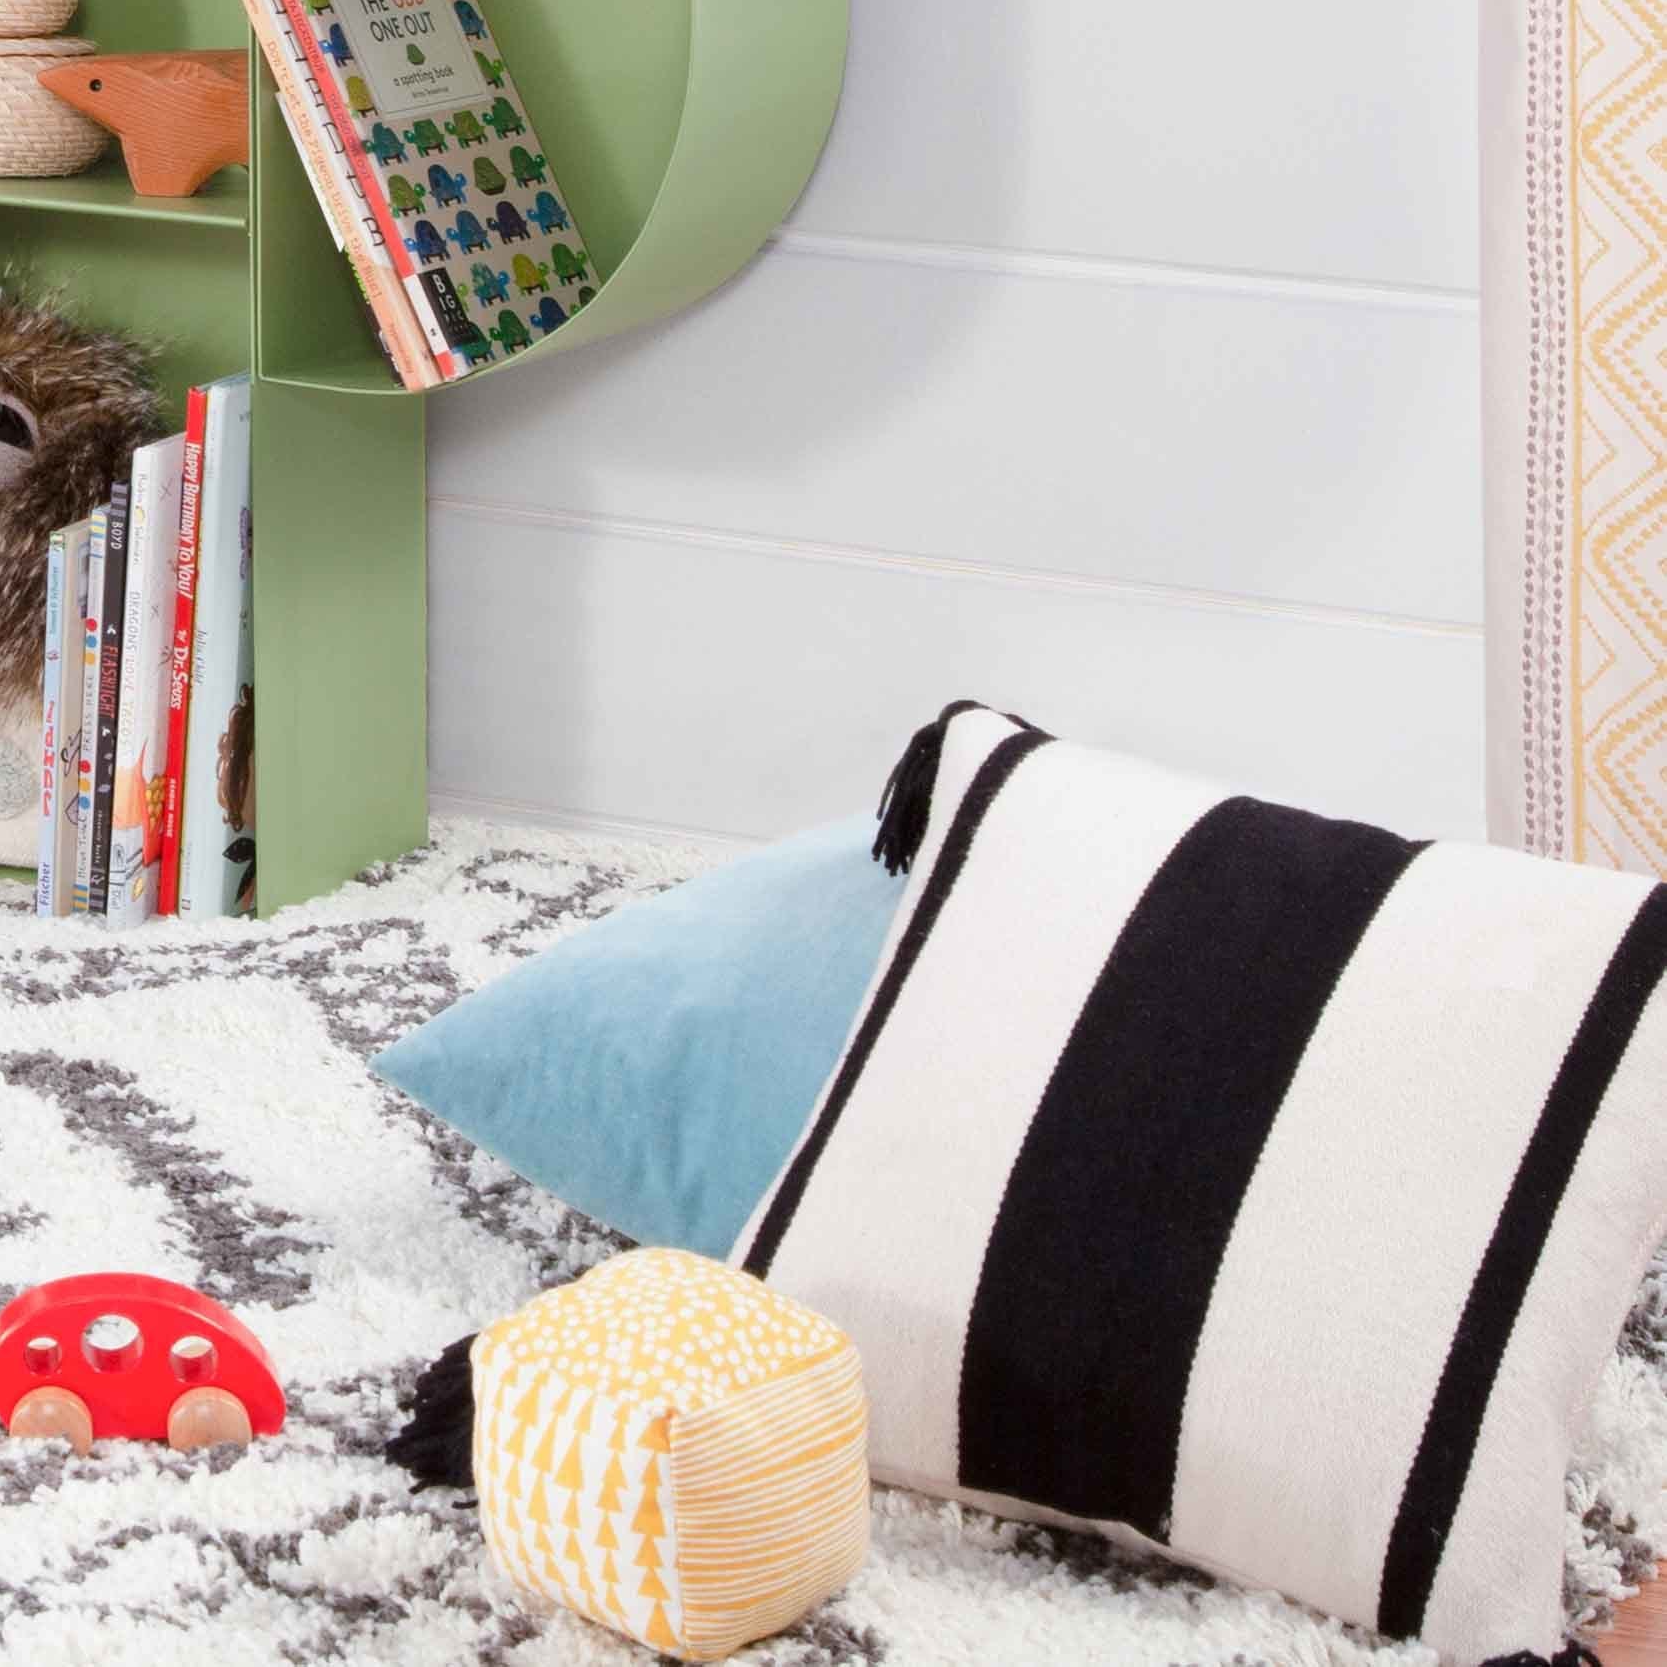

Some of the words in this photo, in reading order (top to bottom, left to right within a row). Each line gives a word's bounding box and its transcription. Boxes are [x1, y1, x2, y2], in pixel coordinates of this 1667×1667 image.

[369, 16, 404, 42] ONE
[404, 11, 436, 36] OUT
[400, 69, 436, 88] spotting
[432, 64, 454, 79] book
[111, 521, 125, 550] BOYD
[126, 590, 141, 651] DRAGONS
[173, 644, 190, 667] Dr.
[99, 645, 118, 718] FLASHLIGHT
[38, 862, 49, 907] Fischer
